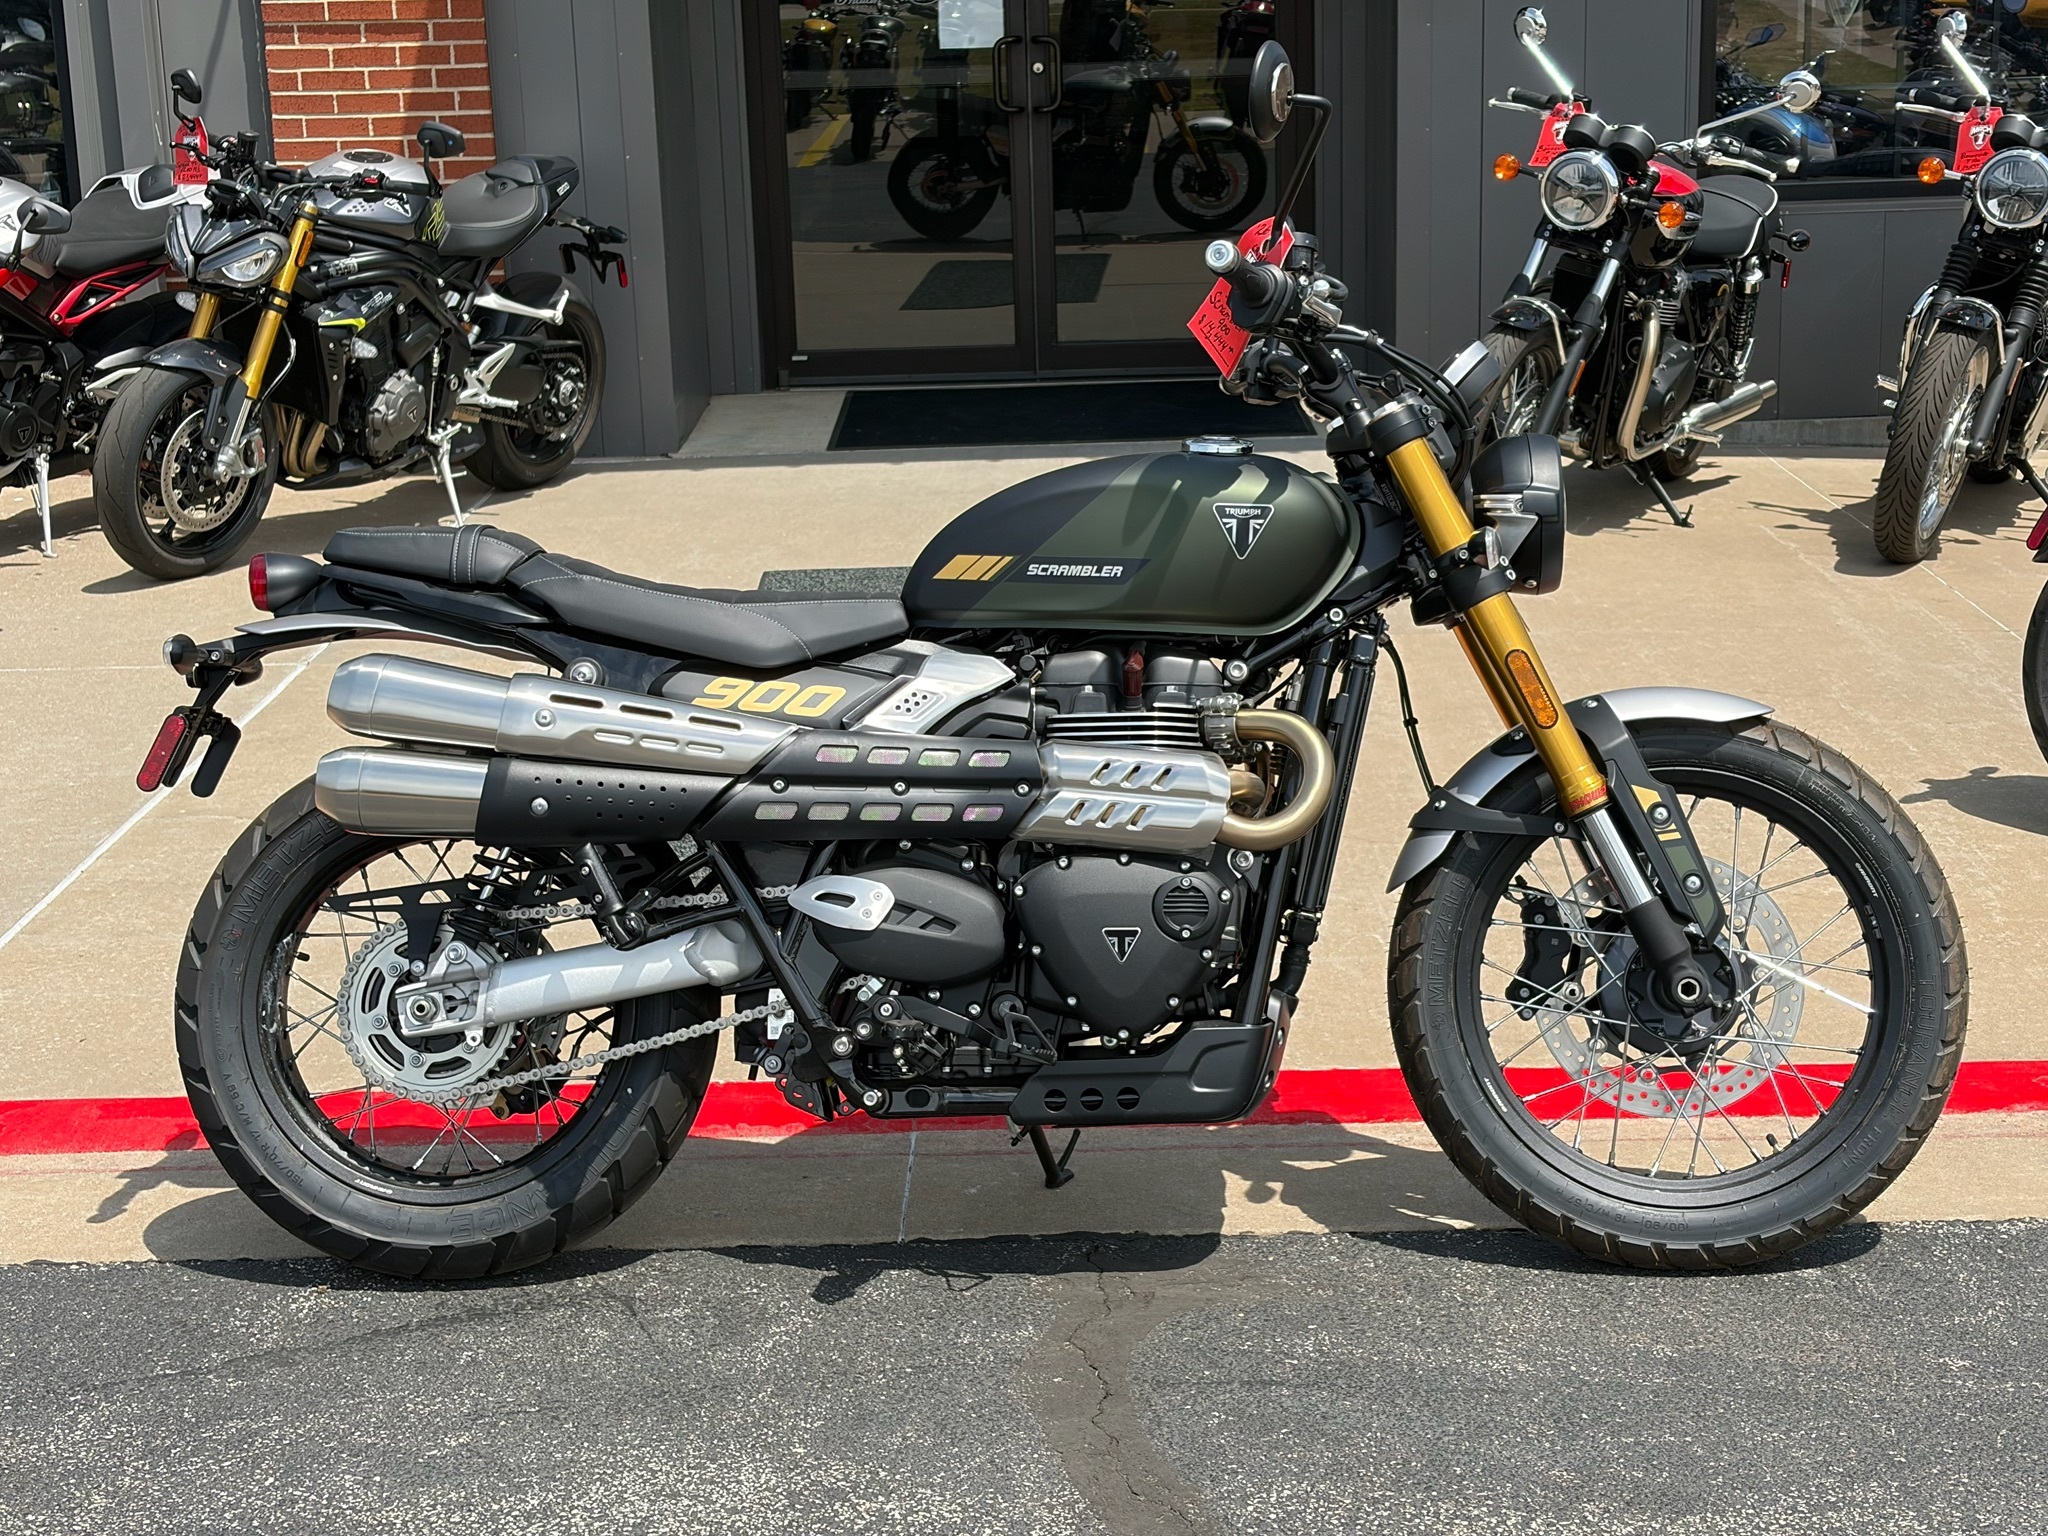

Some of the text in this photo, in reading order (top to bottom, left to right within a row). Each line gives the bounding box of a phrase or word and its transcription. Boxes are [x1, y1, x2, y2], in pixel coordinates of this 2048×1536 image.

[1218, 318, 1232, 336] 900
[1225, 507, 1262, 518] TRIUMPH
[1026, 563, 1124, 579] SCRAMBLER
[690, 676, 847, 718] 900
[1883, 974, 1938, 1125] TOURANCE
[222, 1071, 232, 1082] V
[235, 1103, 254, 1129] M/C
[249, 1129, 262, 1142] 17
[1842, 1126, 1883, 1171] FRONT
[1585, 1203, 1610, 1220] M/C
[1645, 1219, 1691, 1232] 100/90
